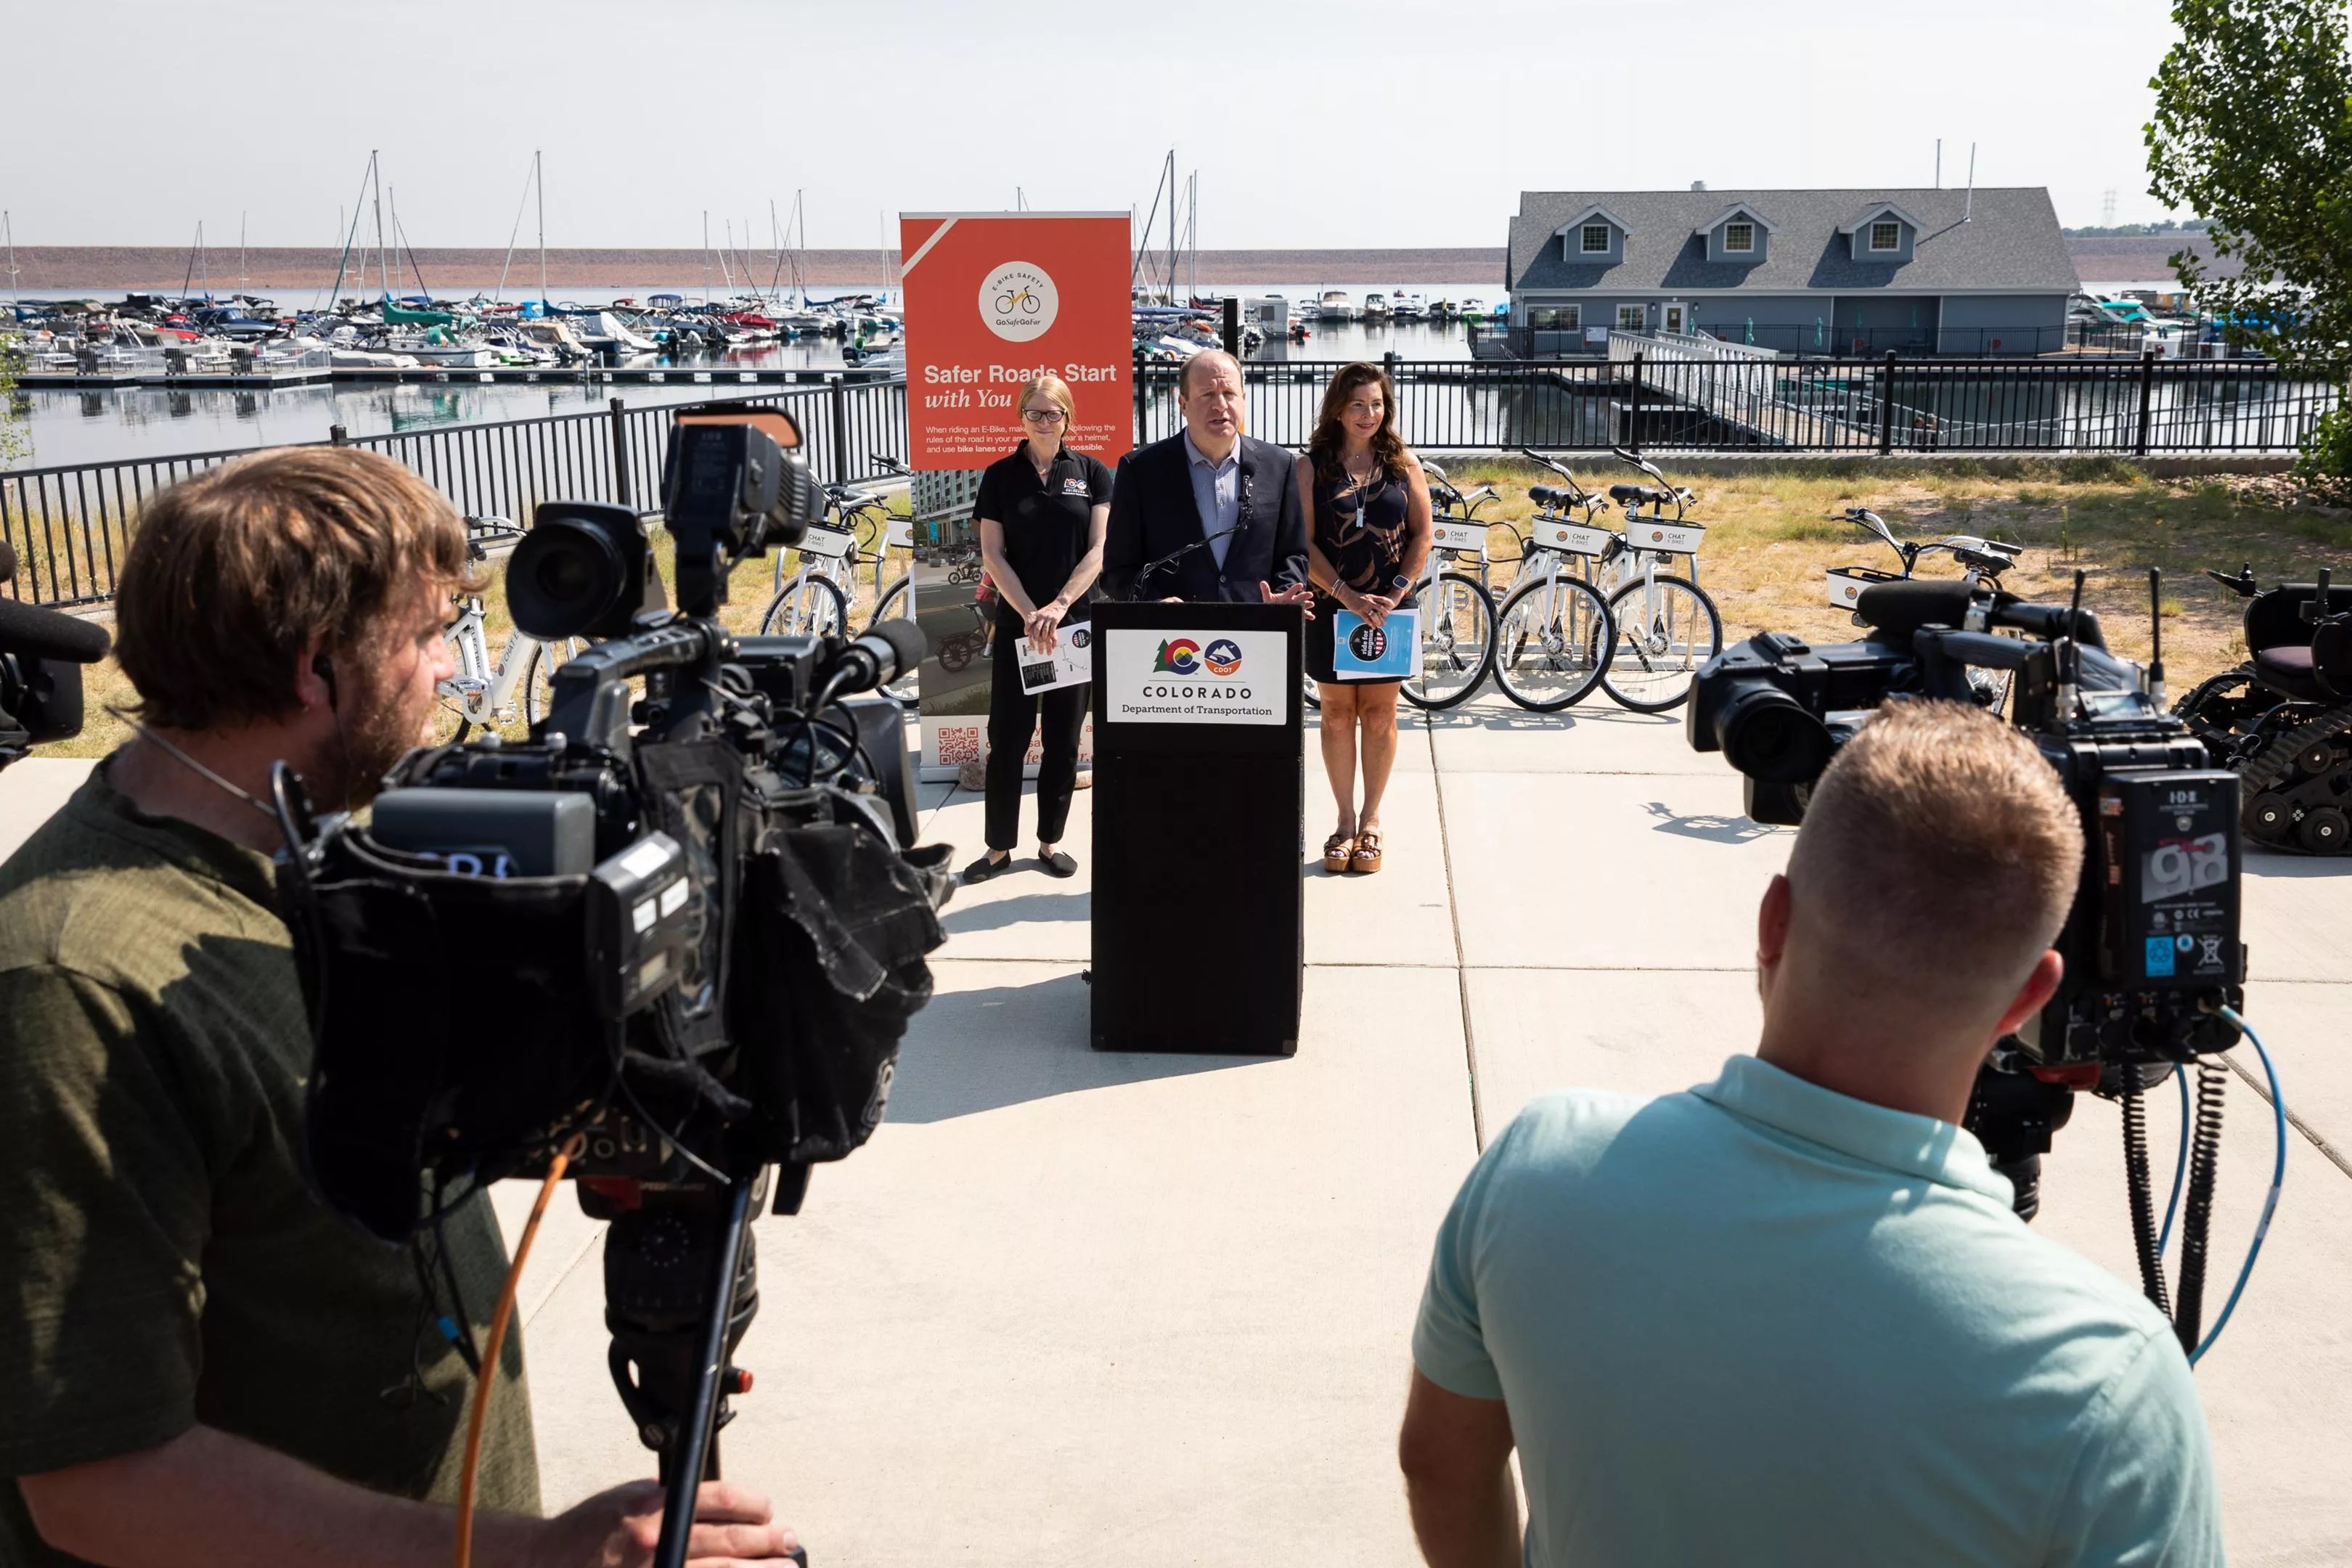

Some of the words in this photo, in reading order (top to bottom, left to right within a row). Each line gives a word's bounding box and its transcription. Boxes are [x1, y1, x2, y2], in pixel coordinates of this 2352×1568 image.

[992, 273, 1014, 291] E-BIKE
[1017, 272, 1044, 288] SAFETY
[996, 318, 1041, 327] GoSafeGoFar
[924, 364, 981, 383] Safer
[1065, 363, 1116, 382] Start
[924, 388, 971, 408] with
[976, 388, 1012, 407] You
[948, 425, 969, 435] riding
[808, 534, 825, 542] CHAT
[1143, 686, 1251, 699] COLORADO
[1122, 704, 1182, 714] Department
[1184, 705, 1195, 714] of
[1197, 706, 1273, 716] Transportation
